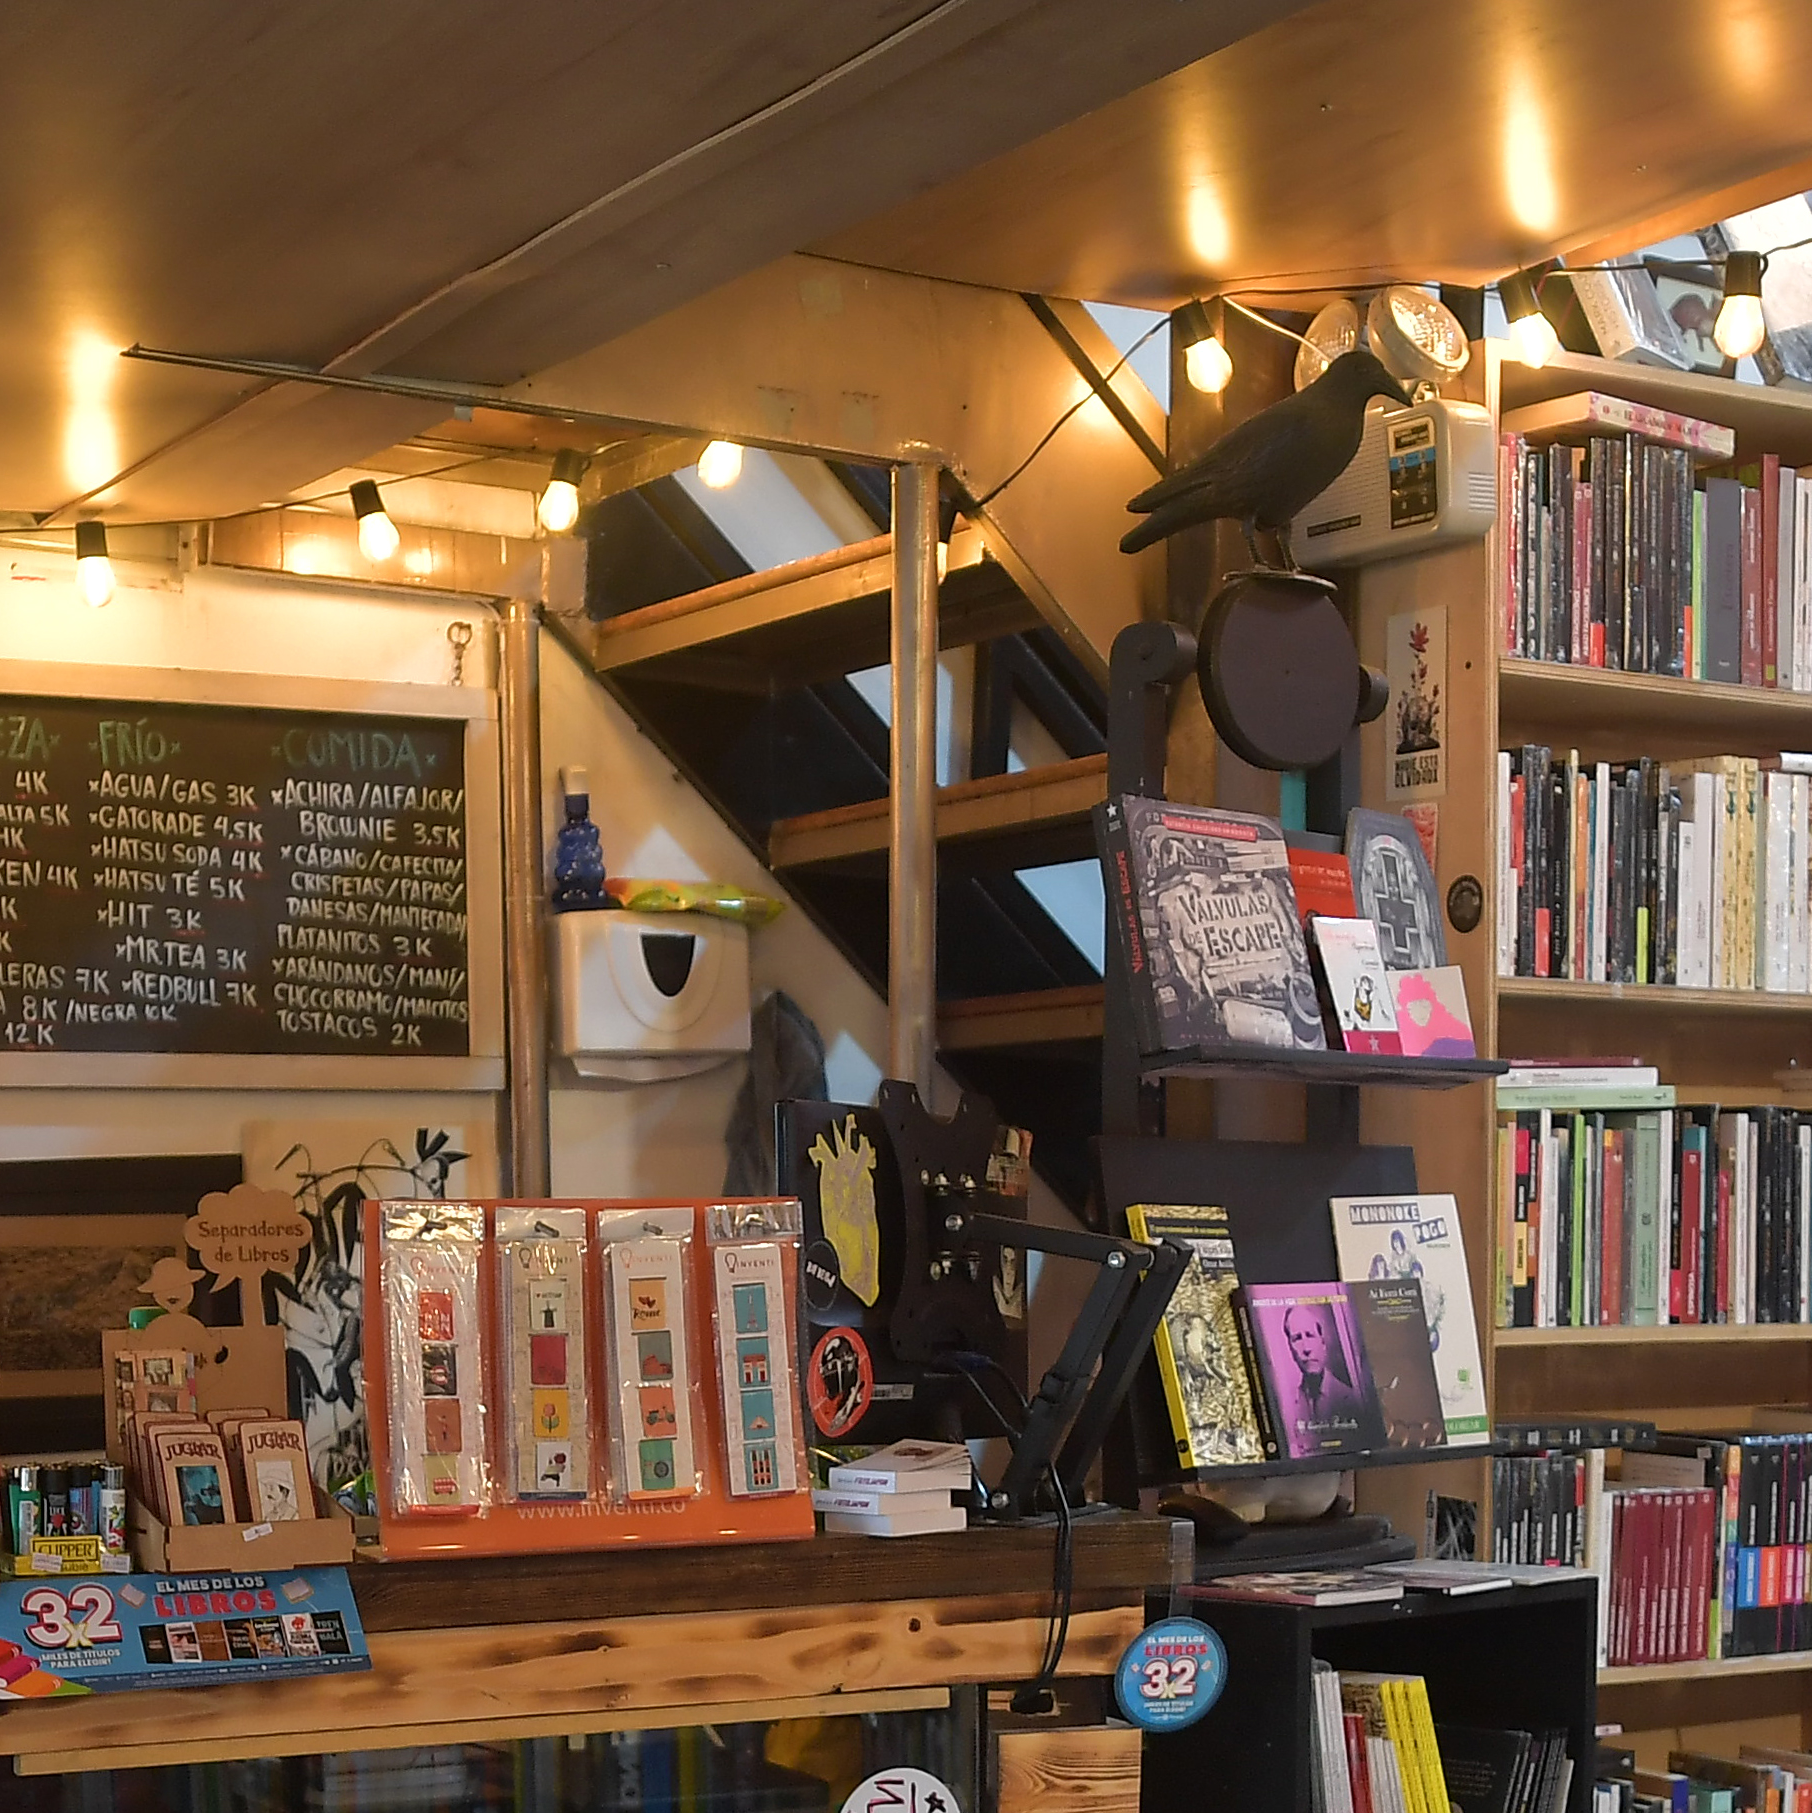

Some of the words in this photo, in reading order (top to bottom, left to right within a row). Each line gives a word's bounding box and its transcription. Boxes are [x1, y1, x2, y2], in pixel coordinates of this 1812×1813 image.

[15, 770, 48, 795] 4K
[99, 806, 205, 837] GATORADE
[299, 811, 396, 841] BROWNIE
[108, 902, 153, 929] HIT
[1204, 922, 1282, 957] ESCAPE
[1350, 1203, 1420, 1224] MONONOKE
[199, 1221, 303, 1238] Separadores
[1414, 1218, 1447, 1243] POGO
[215, 1250, 233, 1262] de
[238, 1248, 289, 1262] Libros
[156, 1581, 174, 1594] EL
[177, 1579, 210, 1591] MES
[213, 1578, 233, 1589] DE
[236, 1575, 265, 1589] LOS
[154, 1590, 276, 1616] LIBROS
[1145, 1644, 1208, 1656] LIBROS
[50, 1658, 78, 1669] PARA
